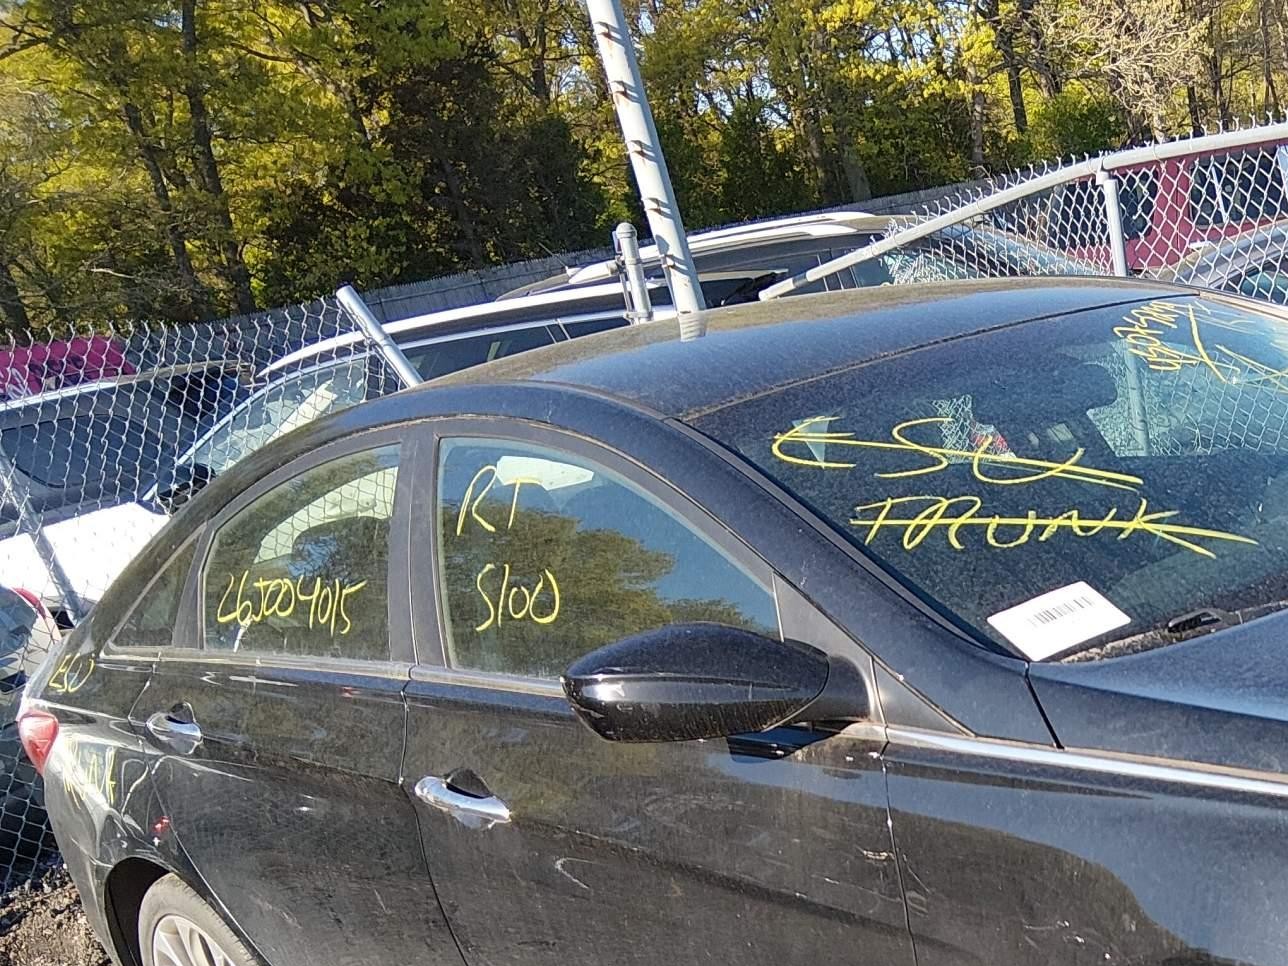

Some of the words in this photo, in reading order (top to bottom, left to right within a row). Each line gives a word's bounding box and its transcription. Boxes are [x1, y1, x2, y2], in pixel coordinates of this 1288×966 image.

[456, 465, 543, 536] RT
[849, 497, 1220, 562] TRUNK
[475, 563, 561, 632] S100
